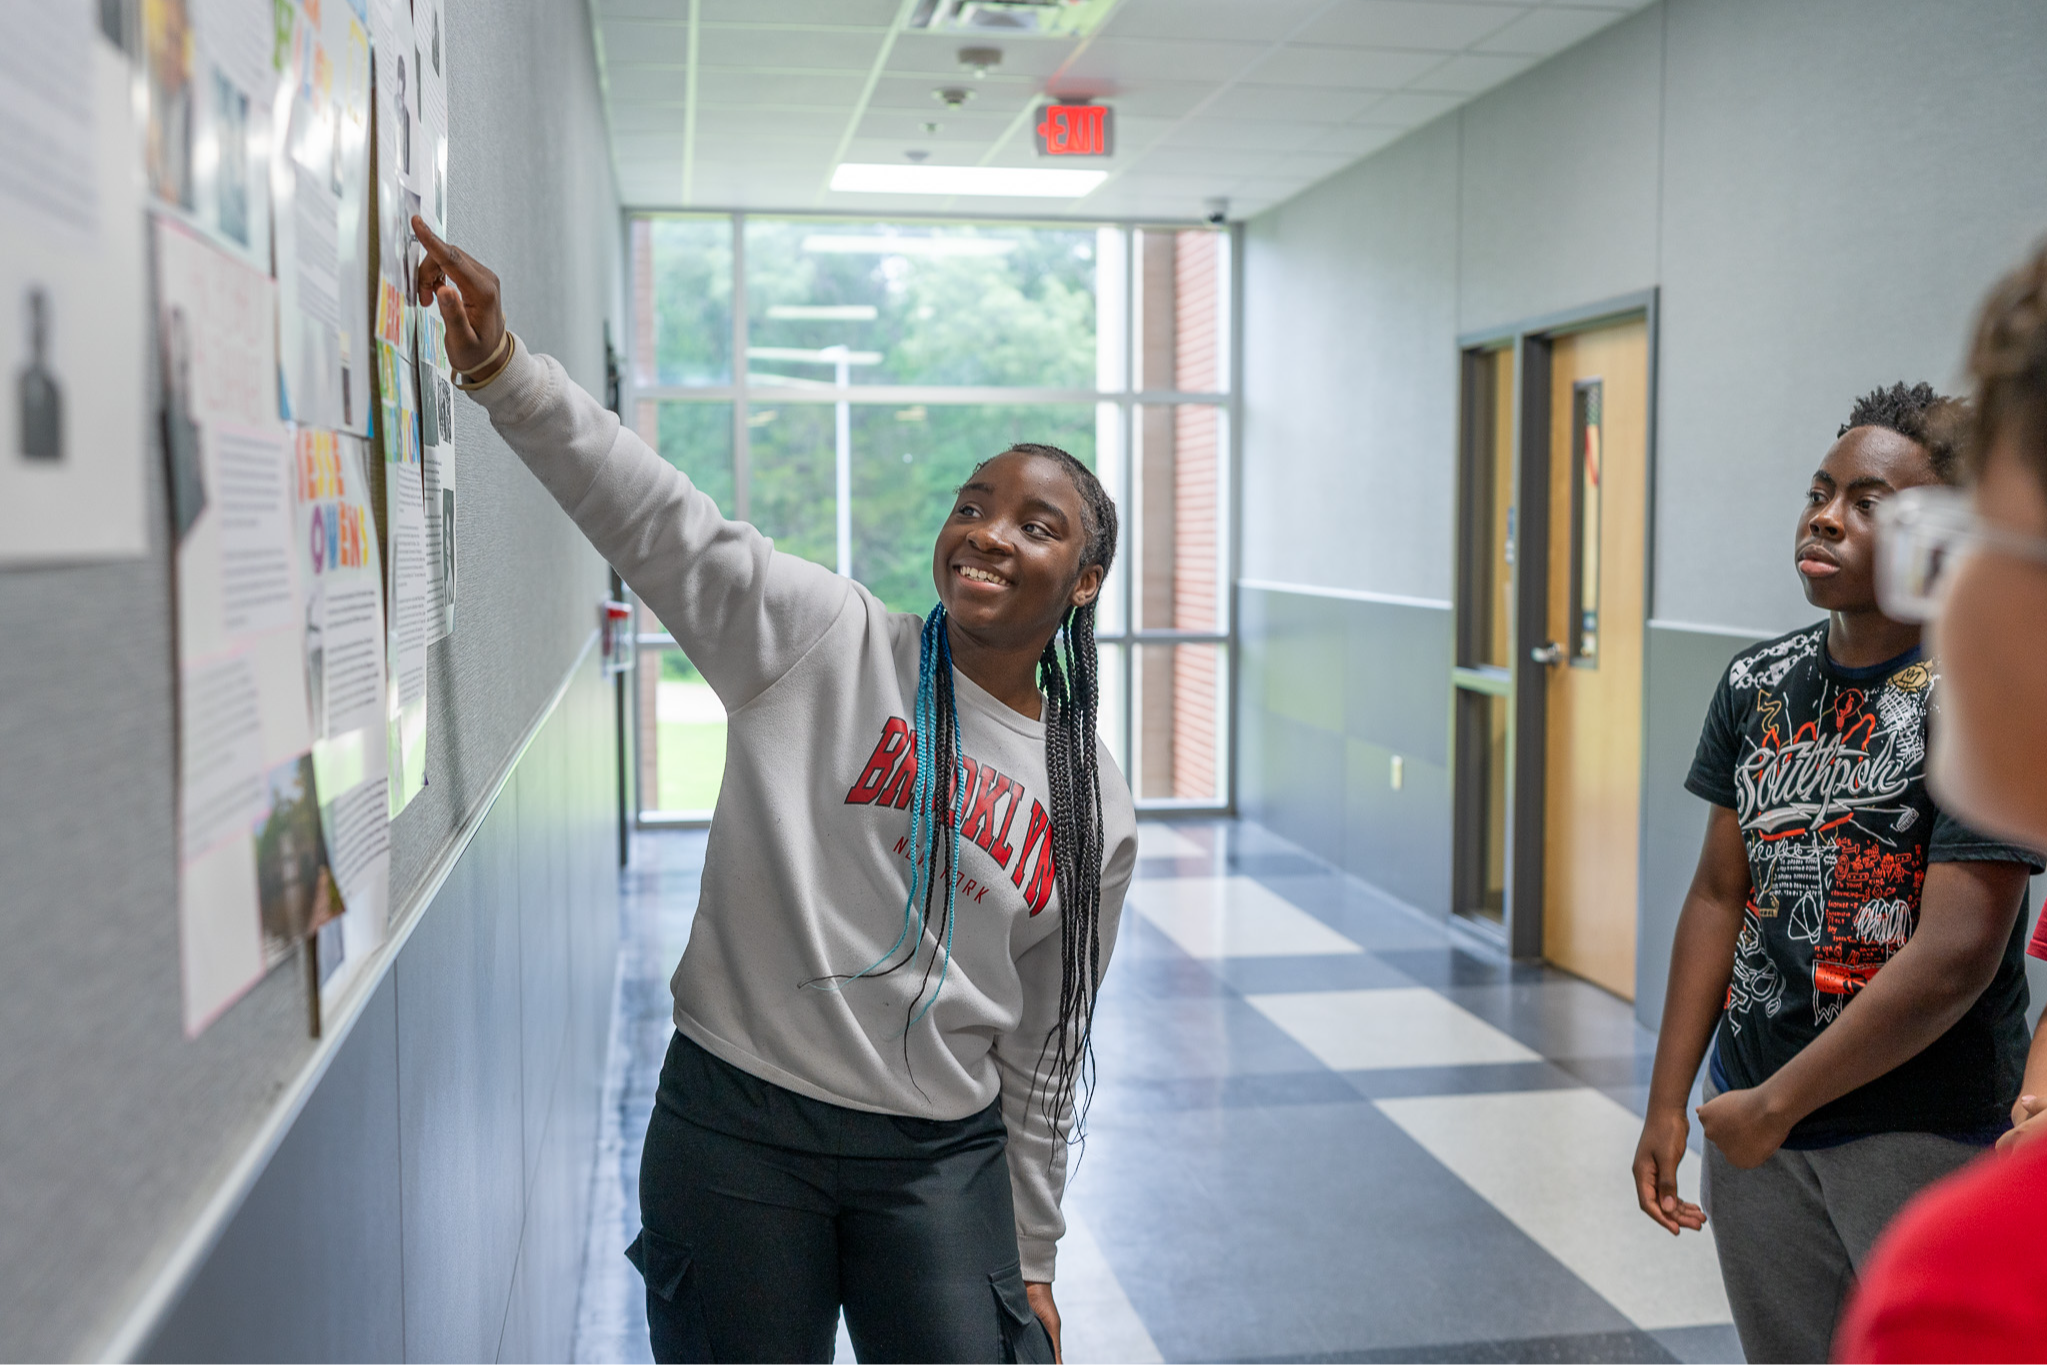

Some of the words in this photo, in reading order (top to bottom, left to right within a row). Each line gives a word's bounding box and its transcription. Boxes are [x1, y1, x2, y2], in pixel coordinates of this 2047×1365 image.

[1046, 105, 1107, 154] EXIT
[295, 428, 344, 503] JESSE
[310, 501, 369, 576] OWENS
[844, 716, 1056, 918] BROKLYN
